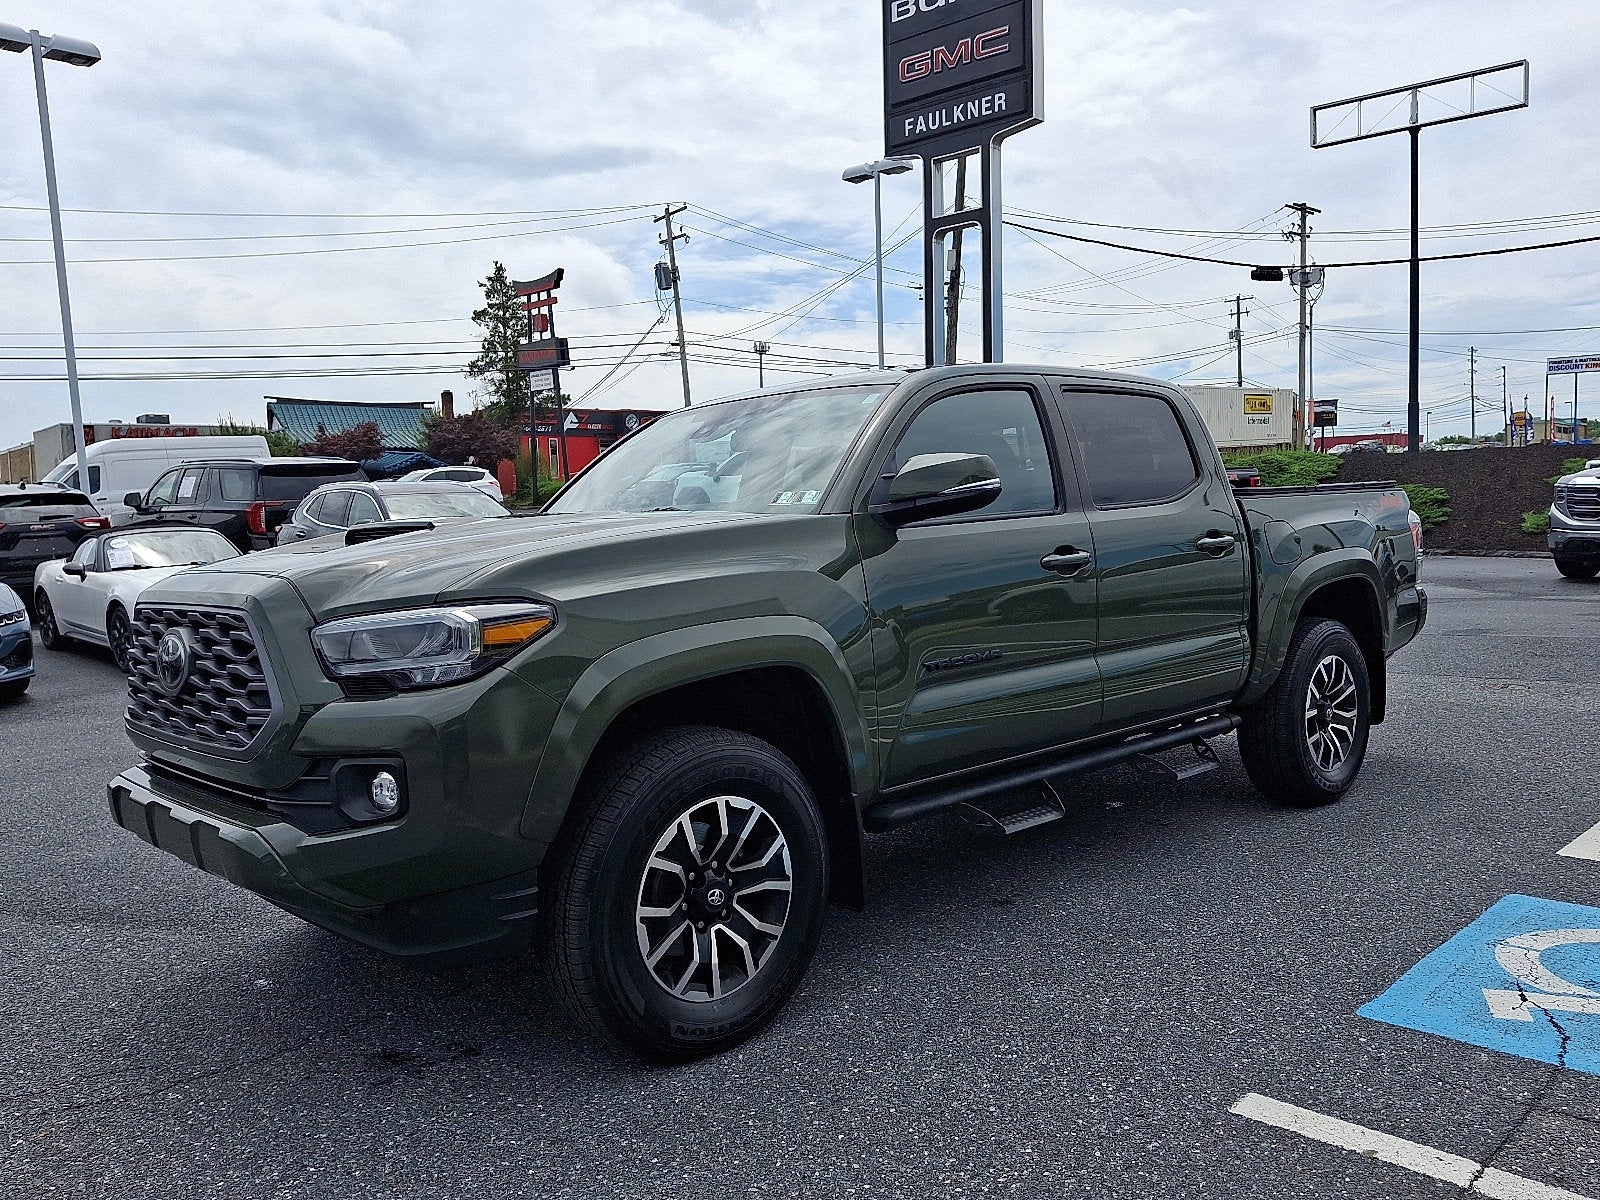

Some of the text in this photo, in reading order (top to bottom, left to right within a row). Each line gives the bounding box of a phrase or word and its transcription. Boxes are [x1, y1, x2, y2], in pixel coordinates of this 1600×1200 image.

[899, 25, 1009, 82] GMC
[904, 92, 1006, 136] FAULKNER
[29, 523, 56, 532] GMC
[923, 649, 1003, 671] TACOMA
